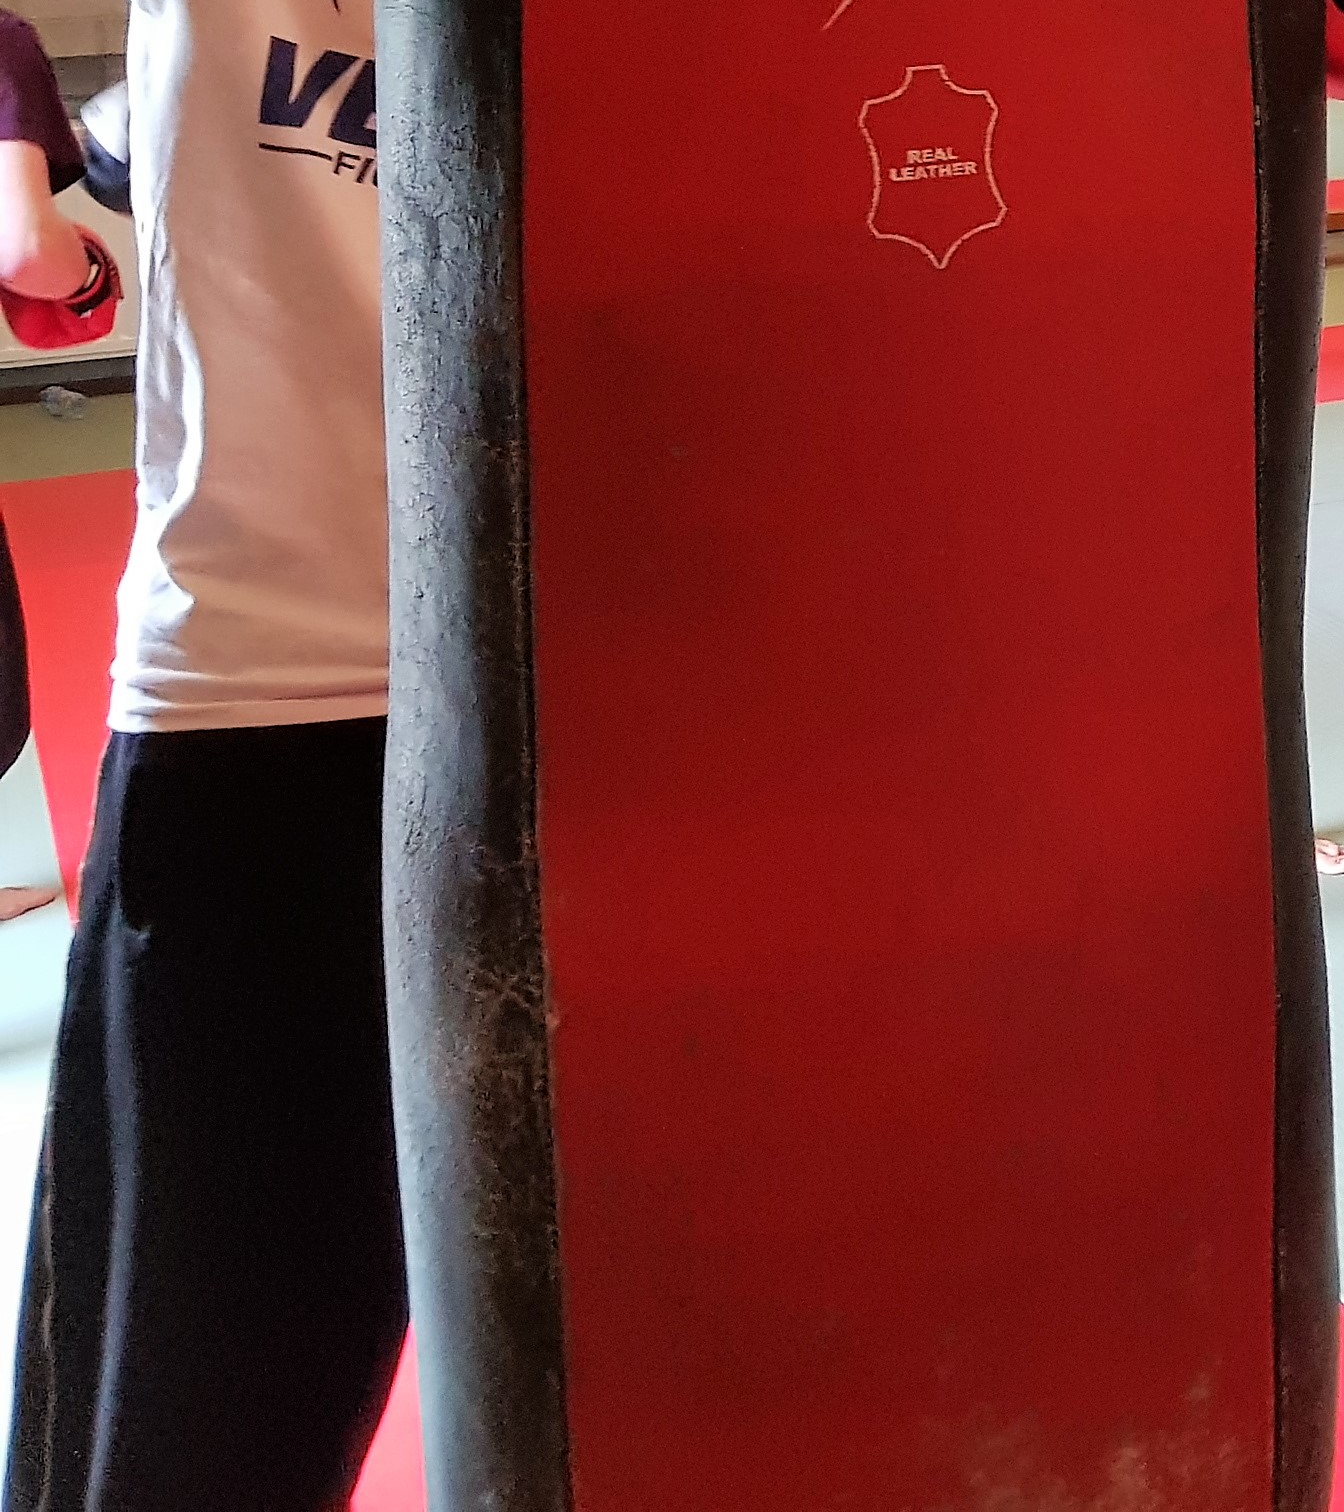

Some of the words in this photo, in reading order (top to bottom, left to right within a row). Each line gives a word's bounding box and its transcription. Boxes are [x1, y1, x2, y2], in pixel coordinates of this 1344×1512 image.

[906, 147, 959, 164] REAL
[333, 150, 378, 188] FI
[888, 161, 978, 182] LEATHER
